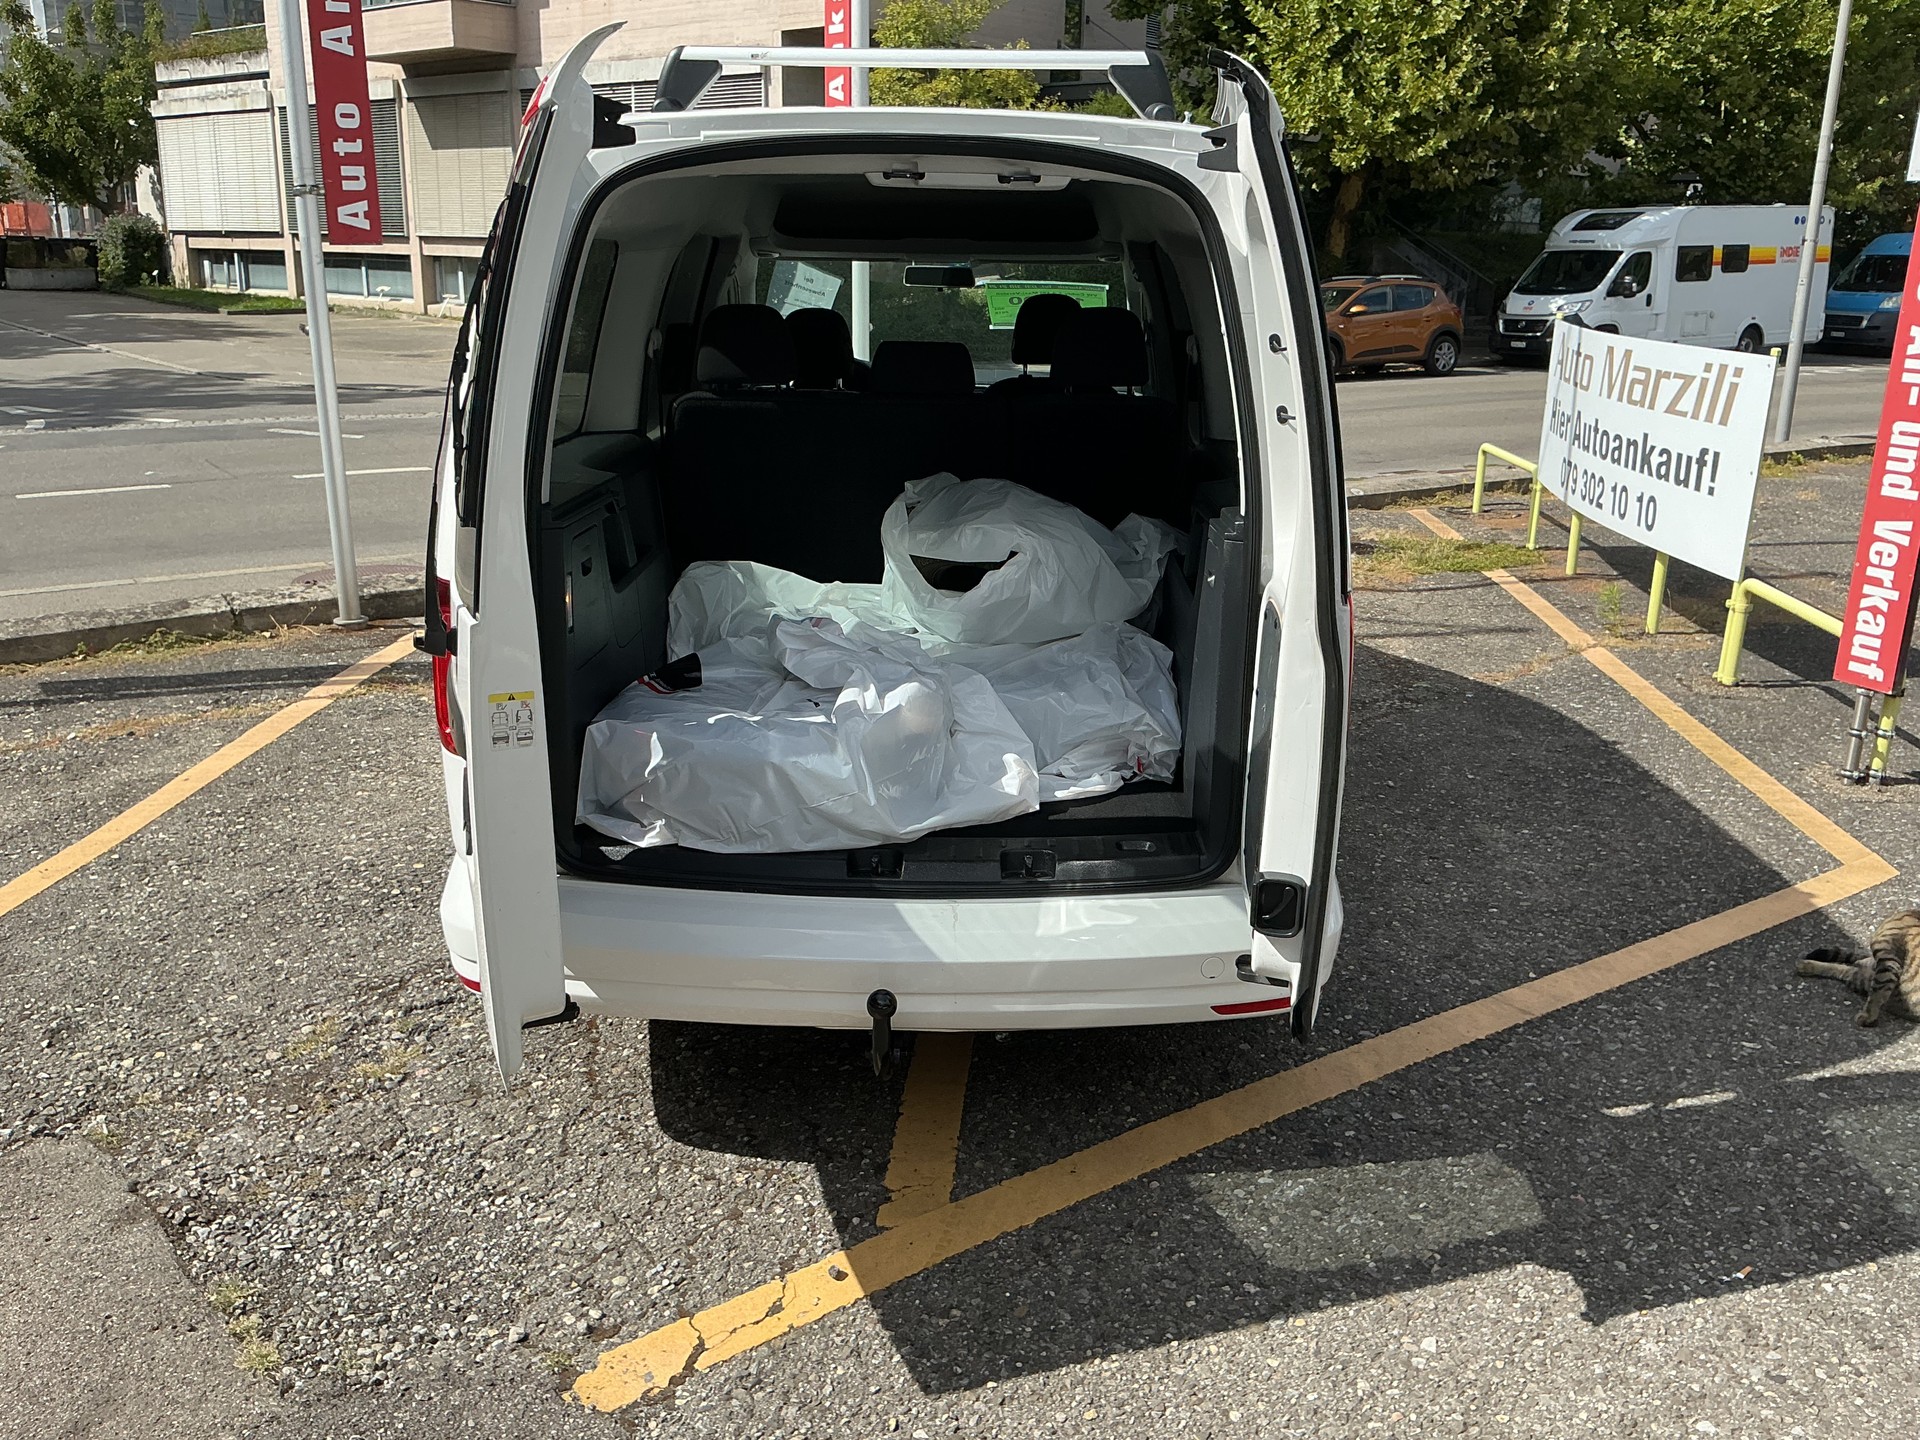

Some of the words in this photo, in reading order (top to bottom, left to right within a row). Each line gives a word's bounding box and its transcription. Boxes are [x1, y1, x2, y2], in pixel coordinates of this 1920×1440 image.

[332, 102, 371, 230] Auto
[1553, 332, 1594, 392] Auto
[1598, 345, 1744, 427] Marzili
[1549, 396, 1572, 441] Hier
[1572, 410, 1720, 497] Autoankauf!
[1560, 456, 1578, 496] 079
[1580, 468, 1605, 510] 302
[1611, 481, 1629, 521] 10
[1636, 491, 1658, 532] 10
[1880, 420, 1920, 501] und
[1847, 520, 1914, 683] Verkauf
